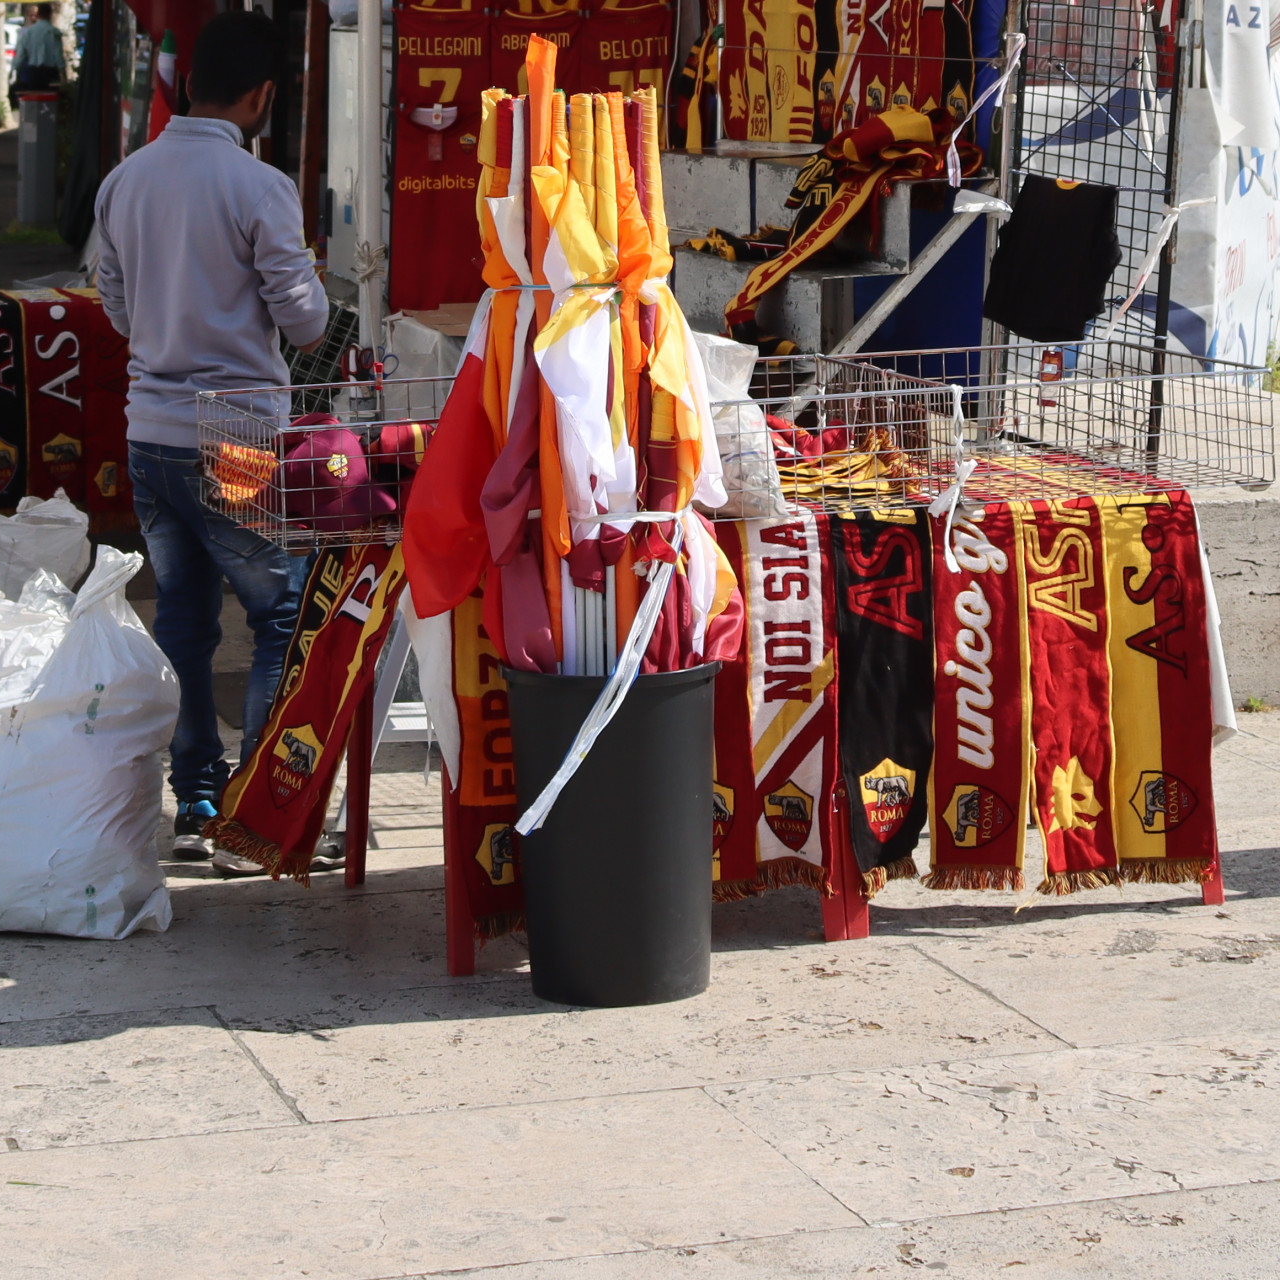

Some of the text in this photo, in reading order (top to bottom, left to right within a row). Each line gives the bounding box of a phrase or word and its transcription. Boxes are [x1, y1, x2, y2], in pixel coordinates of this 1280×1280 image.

[398, 36, 482, 57] PELLEGRINI
[501, 33, 570, 51] ABRAM
[600, 36, 668, 61] BELOTTI
[420, 67, 462, 104] 7
[750, 118, 768, 137] 1927
[398, 174, 475, 194] digitalbits
[764, 620, 812, 704] NOI
[944, 580, 995, 770] unico
[479, 624, 516, 797] FORZ
[272, 764, 302, 792] ROMA
[1169, 780, 1179, 823] ROMA
[773, 820, 807, 835] ROMA
[870, 806, 905, 824] ROMA
[982, 794, 994, 839] ROMA
[879, 823, 894, 833] 1927
